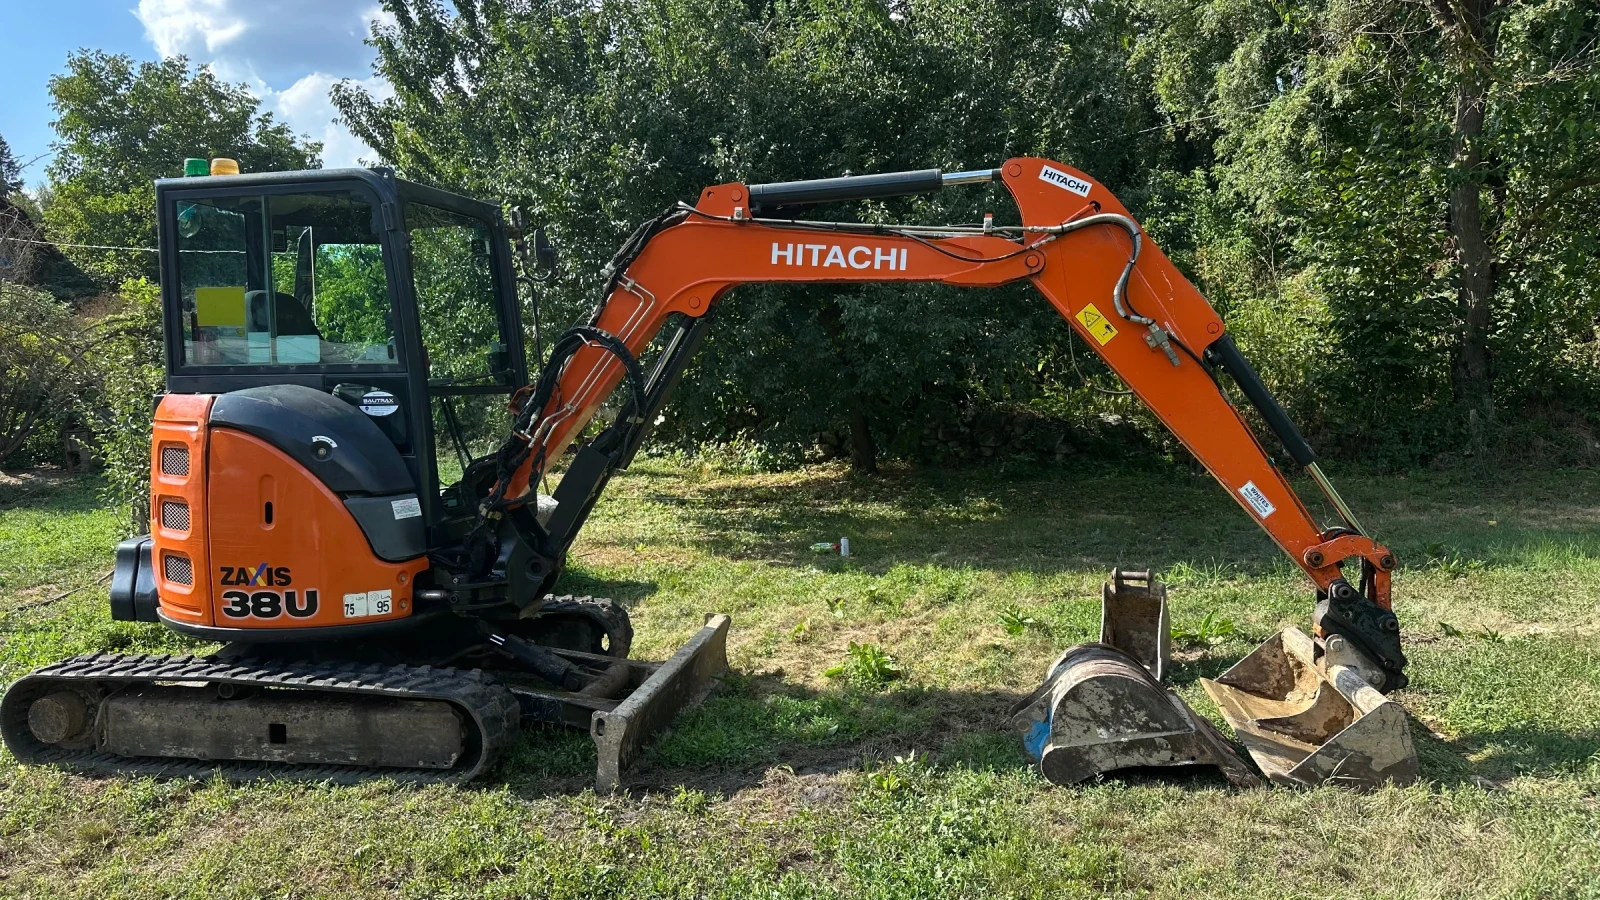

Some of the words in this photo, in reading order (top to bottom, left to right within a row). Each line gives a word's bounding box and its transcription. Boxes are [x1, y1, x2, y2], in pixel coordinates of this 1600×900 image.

[1043, 169, 1088, 193] HITACHI
[771, 242, 907, 271] HITACHI
[1250, 487, 1269, 508] WHITES
[220, 563, 292, 587] ZAXIS
[222, 589, 318, 618] 38U
[344, 603, 355, 616] 75
[376, 600, 390, 613] 95
